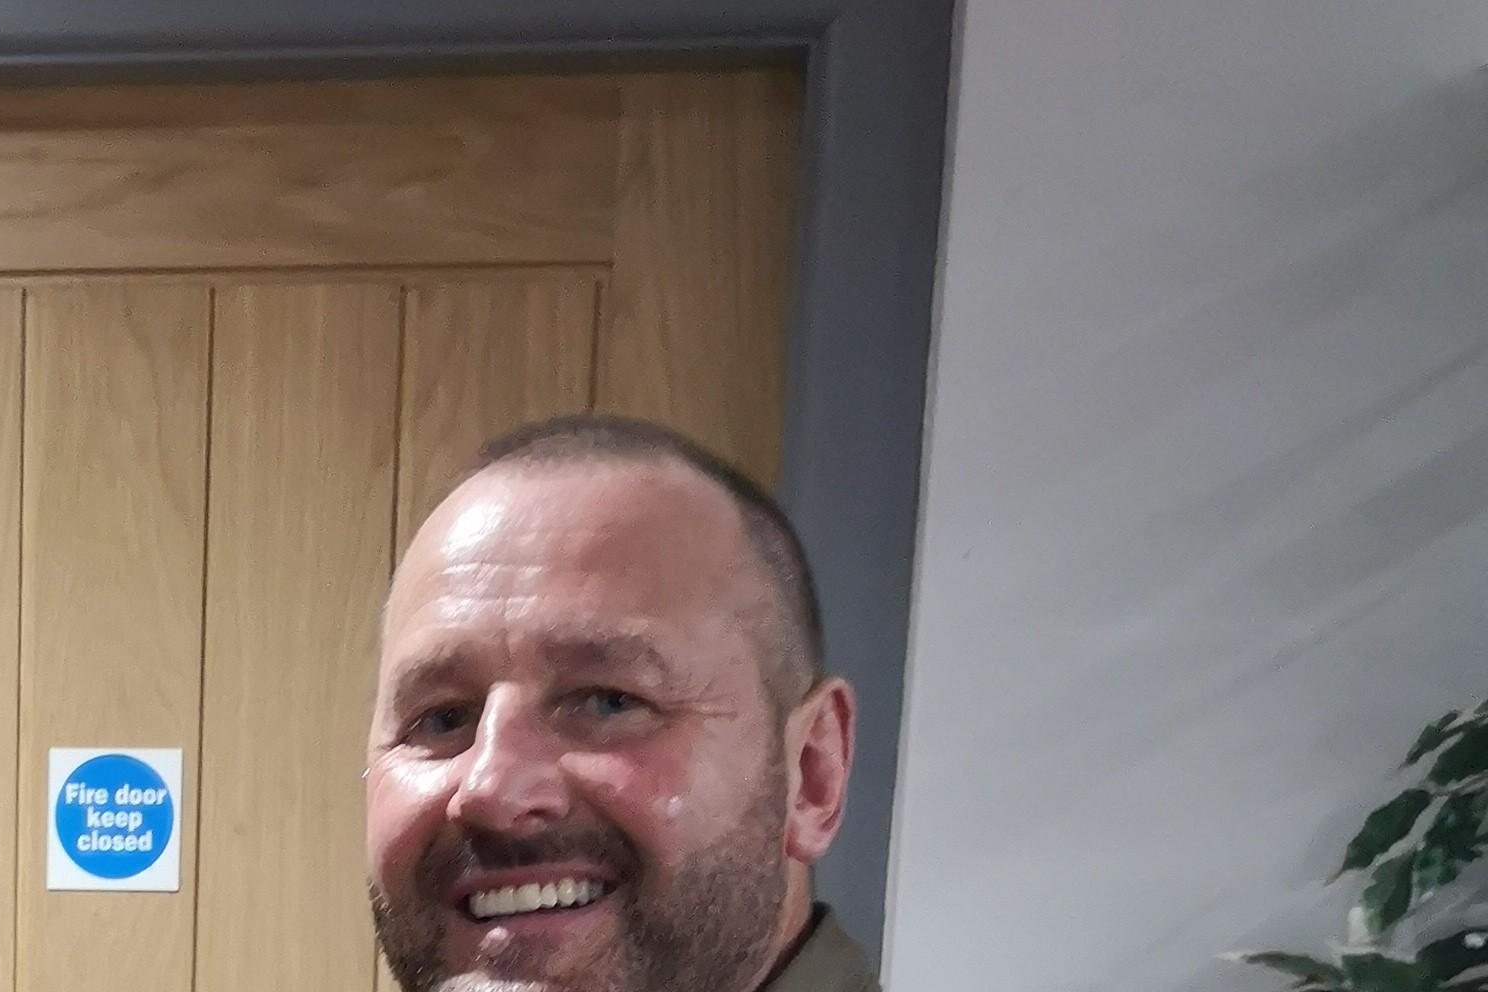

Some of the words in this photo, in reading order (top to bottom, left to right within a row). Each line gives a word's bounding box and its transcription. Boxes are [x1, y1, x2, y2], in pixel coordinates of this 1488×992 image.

[64, 782, 109, 805] Fire
[114, 783, 167, 806] door
[86, 806, 143, 832] keep
[76, 830, 153, 852] closed
